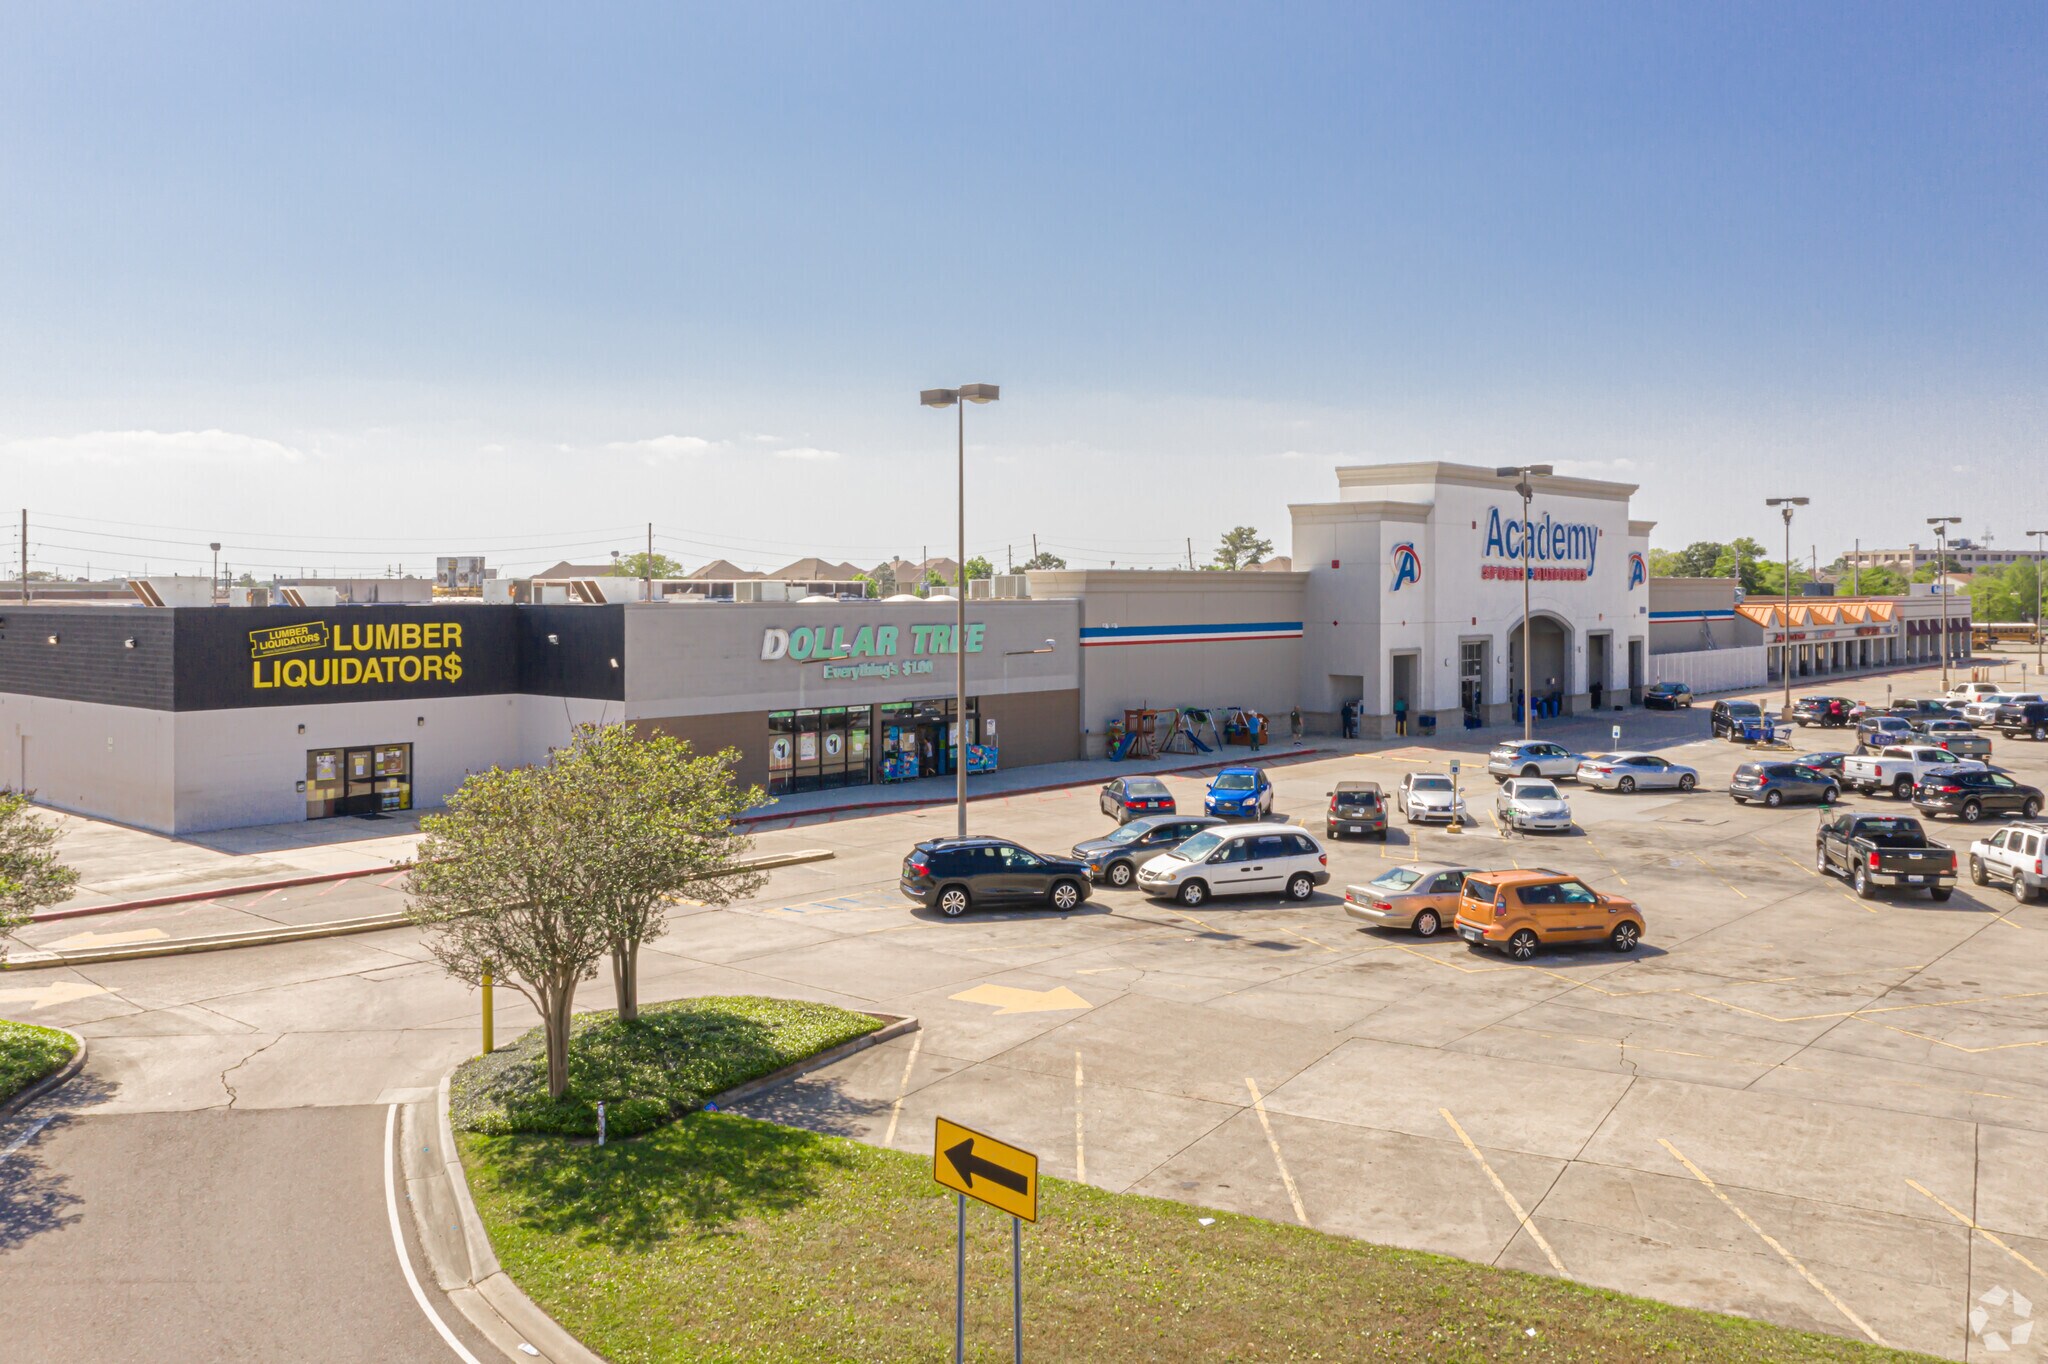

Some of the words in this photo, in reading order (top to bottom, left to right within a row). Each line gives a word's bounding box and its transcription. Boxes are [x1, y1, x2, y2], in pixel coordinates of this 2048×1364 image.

[1484, 506, 1598, 577] Academy
[269, 626, 309, 640] LUMBER
[333, 622, 463, 651] LUMBER
[760, 624, 899, 660] DOLLAR
[911, 622, 986, 655] TREE
[253, 651, 463, 688] LIQUIDATOR$
[823, 660, 899, 681] Everything's
[902, 658, 934, 677] $1.00
